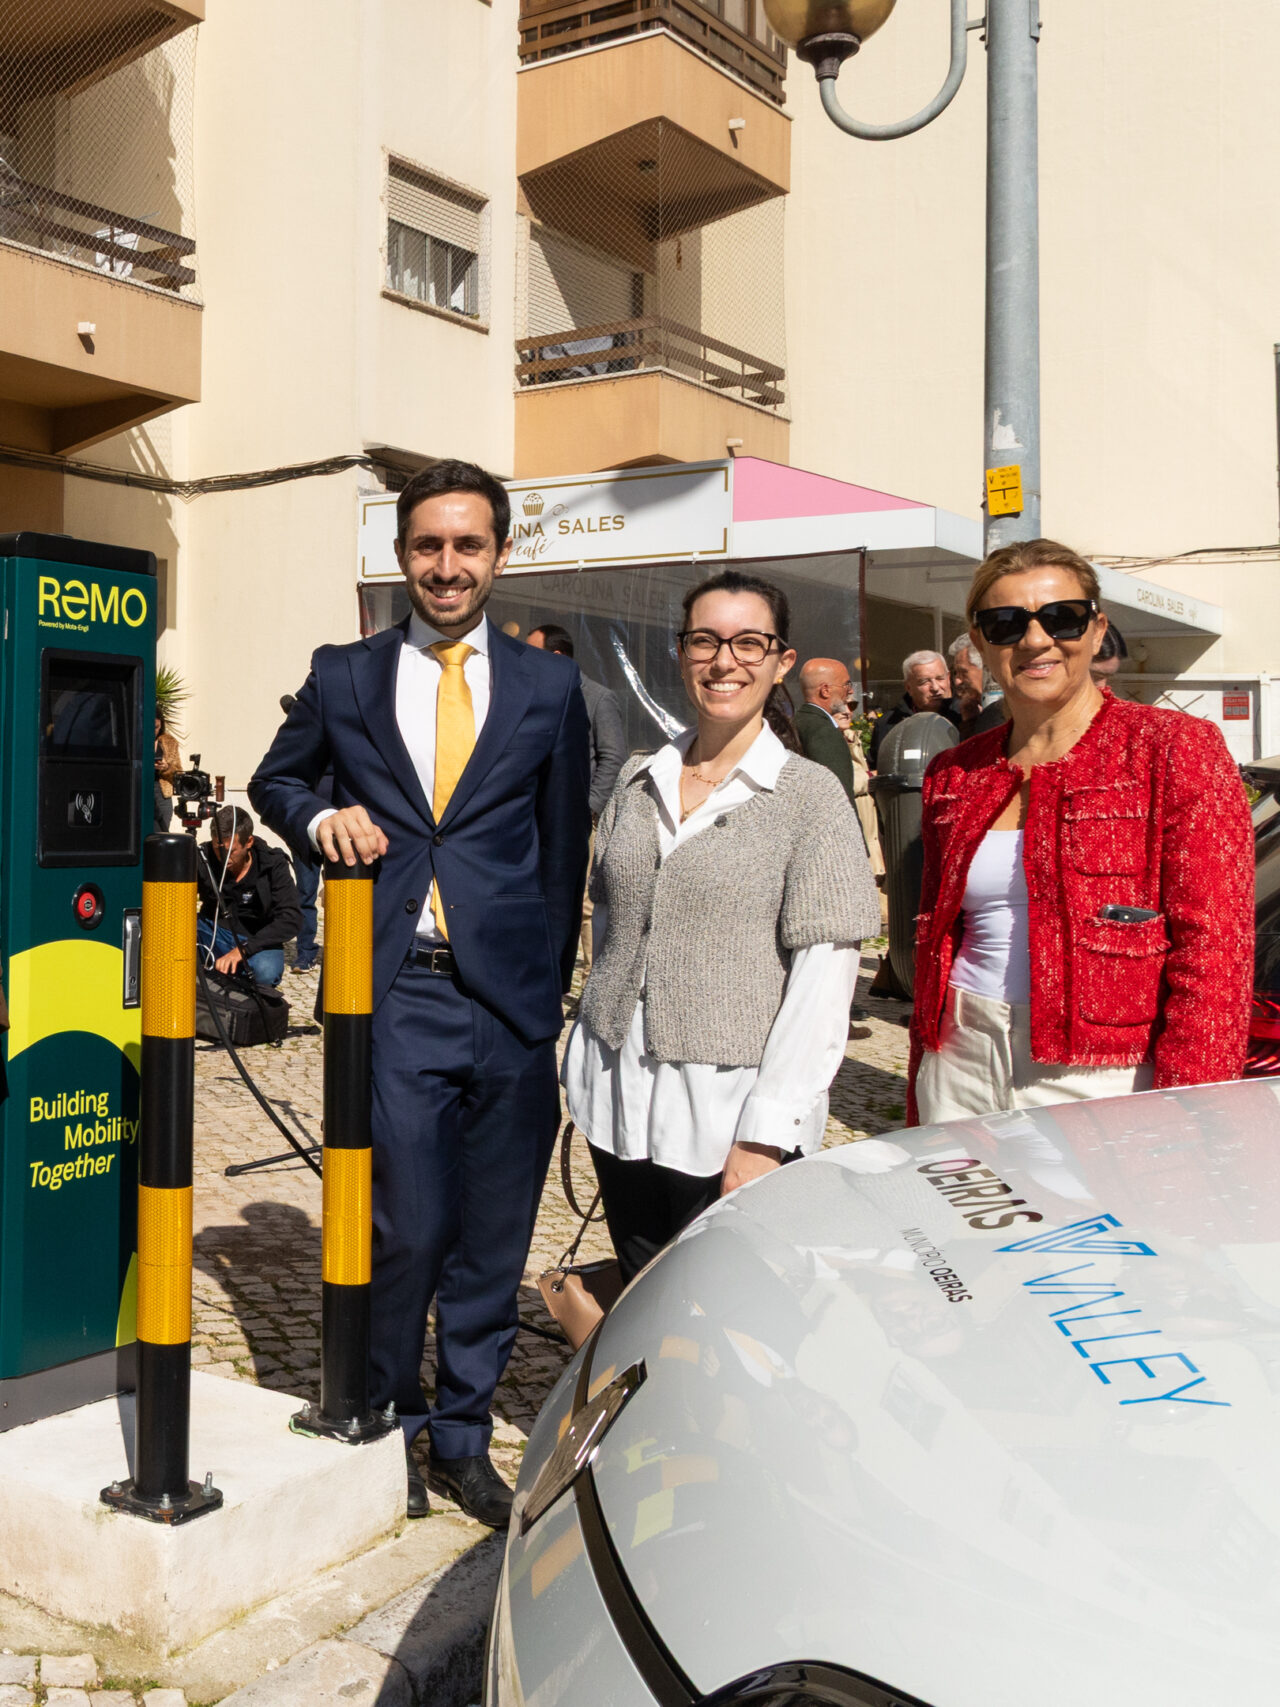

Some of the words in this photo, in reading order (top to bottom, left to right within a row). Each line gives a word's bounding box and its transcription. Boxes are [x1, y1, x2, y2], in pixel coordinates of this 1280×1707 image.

[558, 515, 625, 535] SALES
[515, 538, 548, 560] café
[30, 1089, 109, 1123] Building
[64, 1116, 140, 1151] Mobility
[29, 1152, 116, 1190] Together
[916, 1158, 1044, 1230] OEIRAS
[1022, 1262, 1232, 1406] VALLEY
[929, 1267, 973, 1303] OEIRAS
